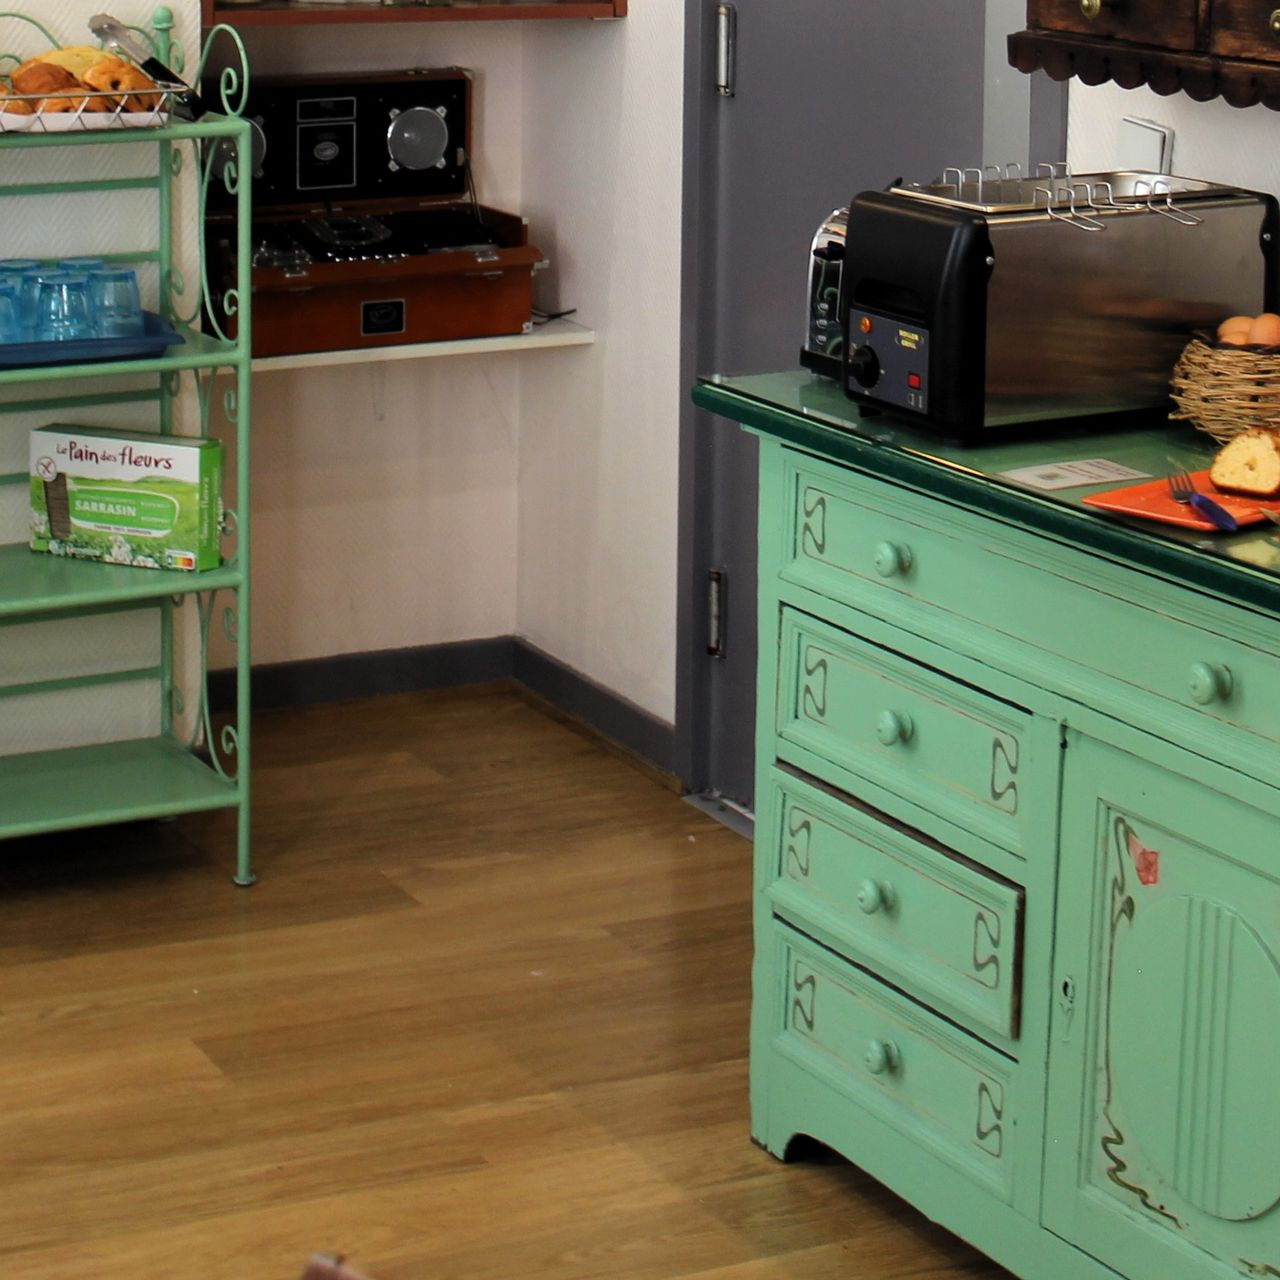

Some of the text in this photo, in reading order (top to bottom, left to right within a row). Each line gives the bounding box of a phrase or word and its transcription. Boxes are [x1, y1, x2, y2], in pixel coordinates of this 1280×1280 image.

[68, 439, 100, 465] Pain
[99, 450, 118, 463] des
[118, 444, 175, 470] fleurs
[74, 499, 138, 517] SARRASIN
